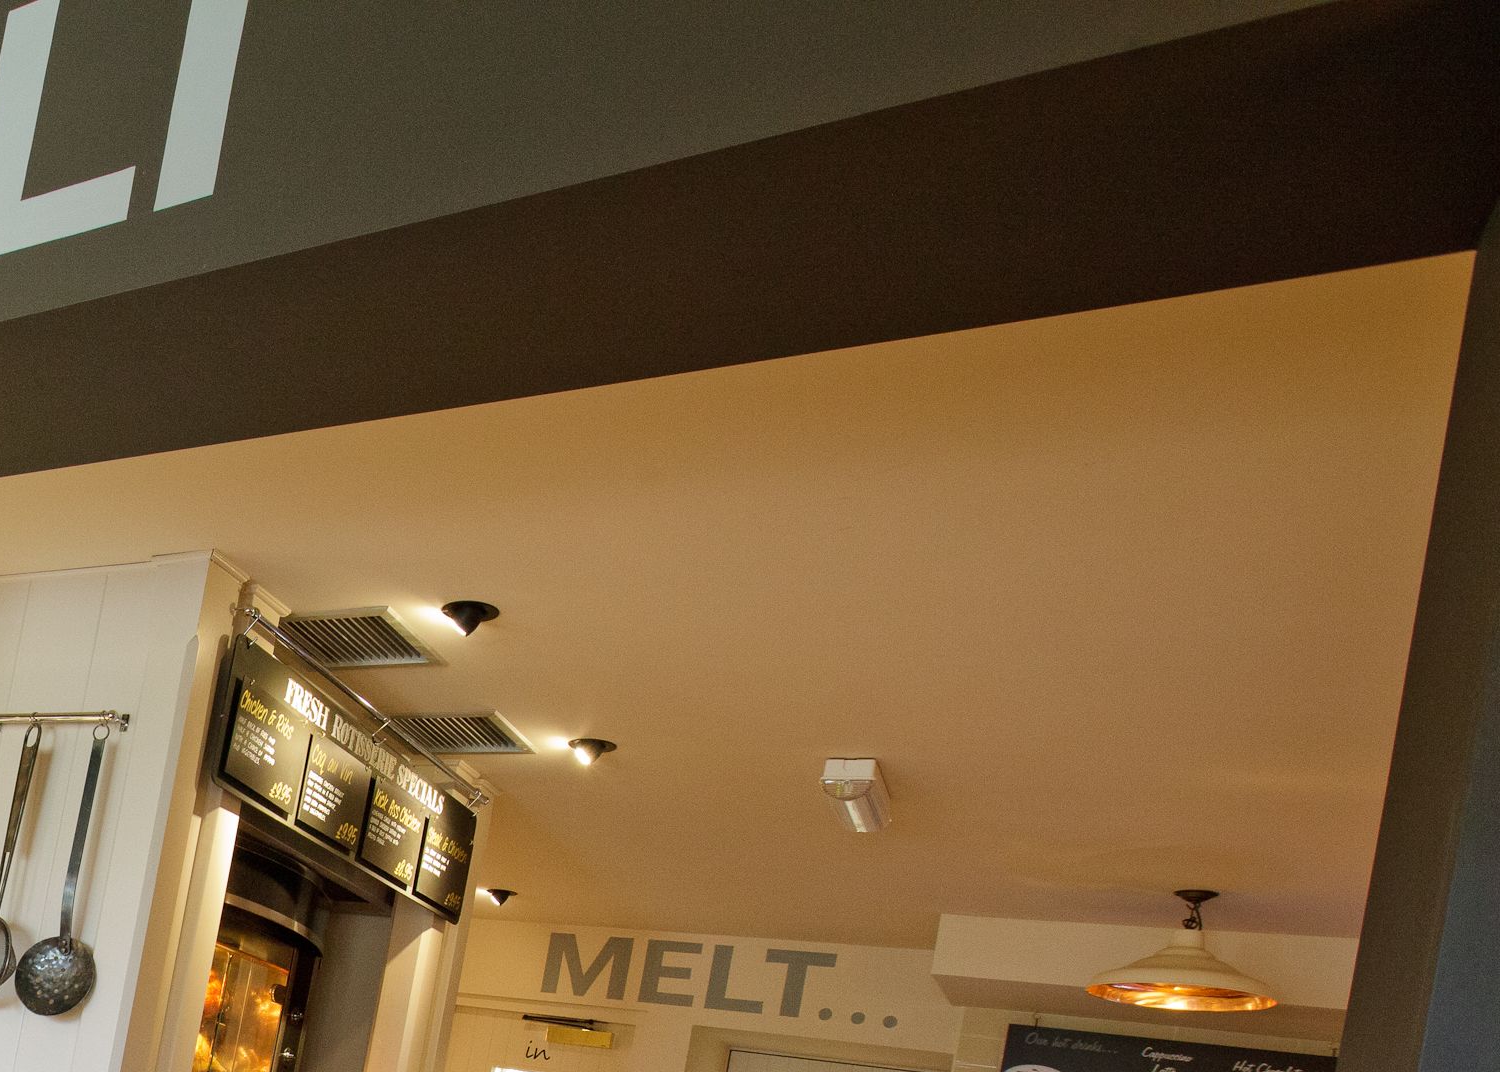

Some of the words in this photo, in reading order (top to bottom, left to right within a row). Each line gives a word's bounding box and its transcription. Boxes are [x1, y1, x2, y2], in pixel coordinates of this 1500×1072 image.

[240, 690, 268, 723] Chicken
[276, 714, 294, 740] Ribs
[284, 678, 330, 731] FRESH
[331, 713, 397, 780] ROTISSERIE
[396, 766, 445, 815] SPECIALS
[312, 744, 327, 775] Coq
[269, 782, 293, 805] £9.95
[373, 788, 389, 811] Kick
[388, 799, 400, 820] Ass
[335, 822, 358, 845] £9.95
[526, 1040, 550, 1060] in
[1025, 1032, 1048, 1045] Our
[1052, 1036, 1069, 1049] hot
[1141, 1047, 1193, 1062] Cappuccino
[1232, 1060, 1255, 1072] Hot
